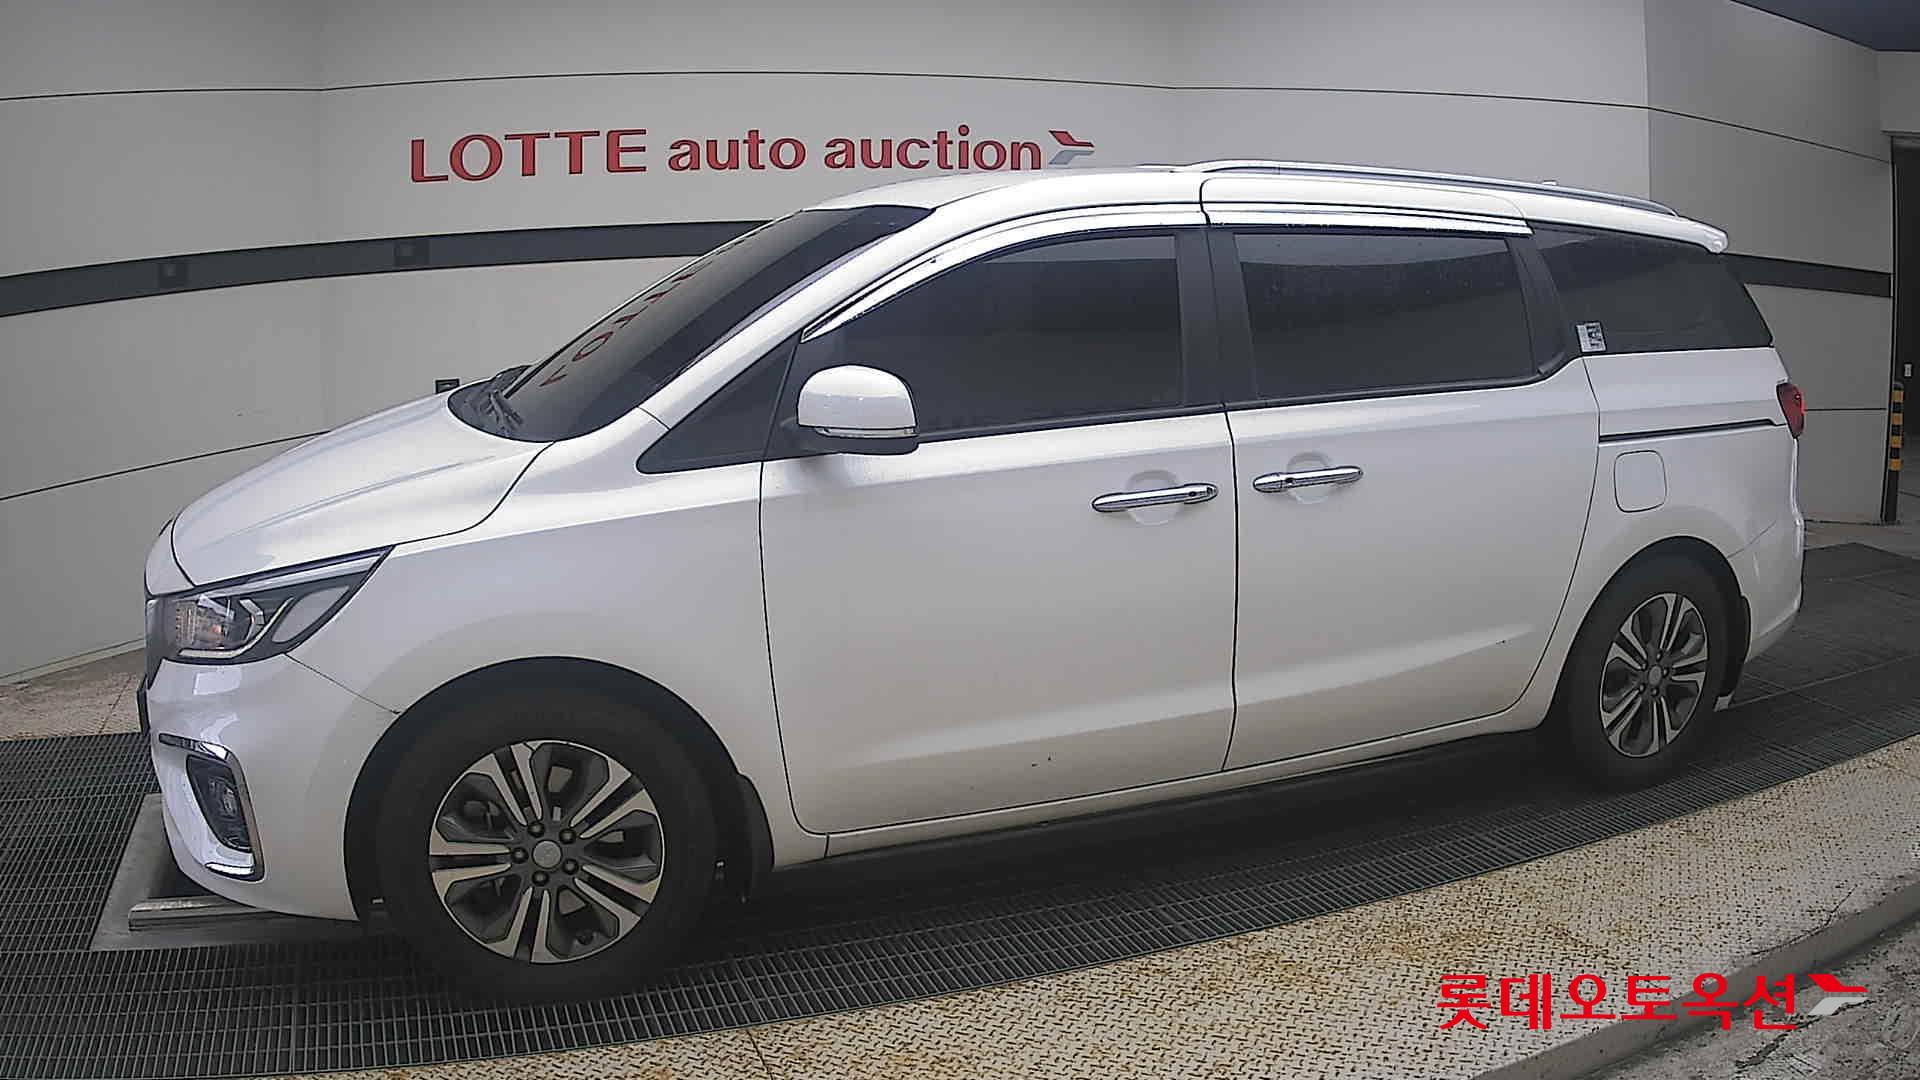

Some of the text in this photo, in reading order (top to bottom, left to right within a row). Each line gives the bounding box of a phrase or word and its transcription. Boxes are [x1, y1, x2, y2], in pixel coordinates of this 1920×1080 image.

[410, 124, 1042, 183] LOTTE auto auction
